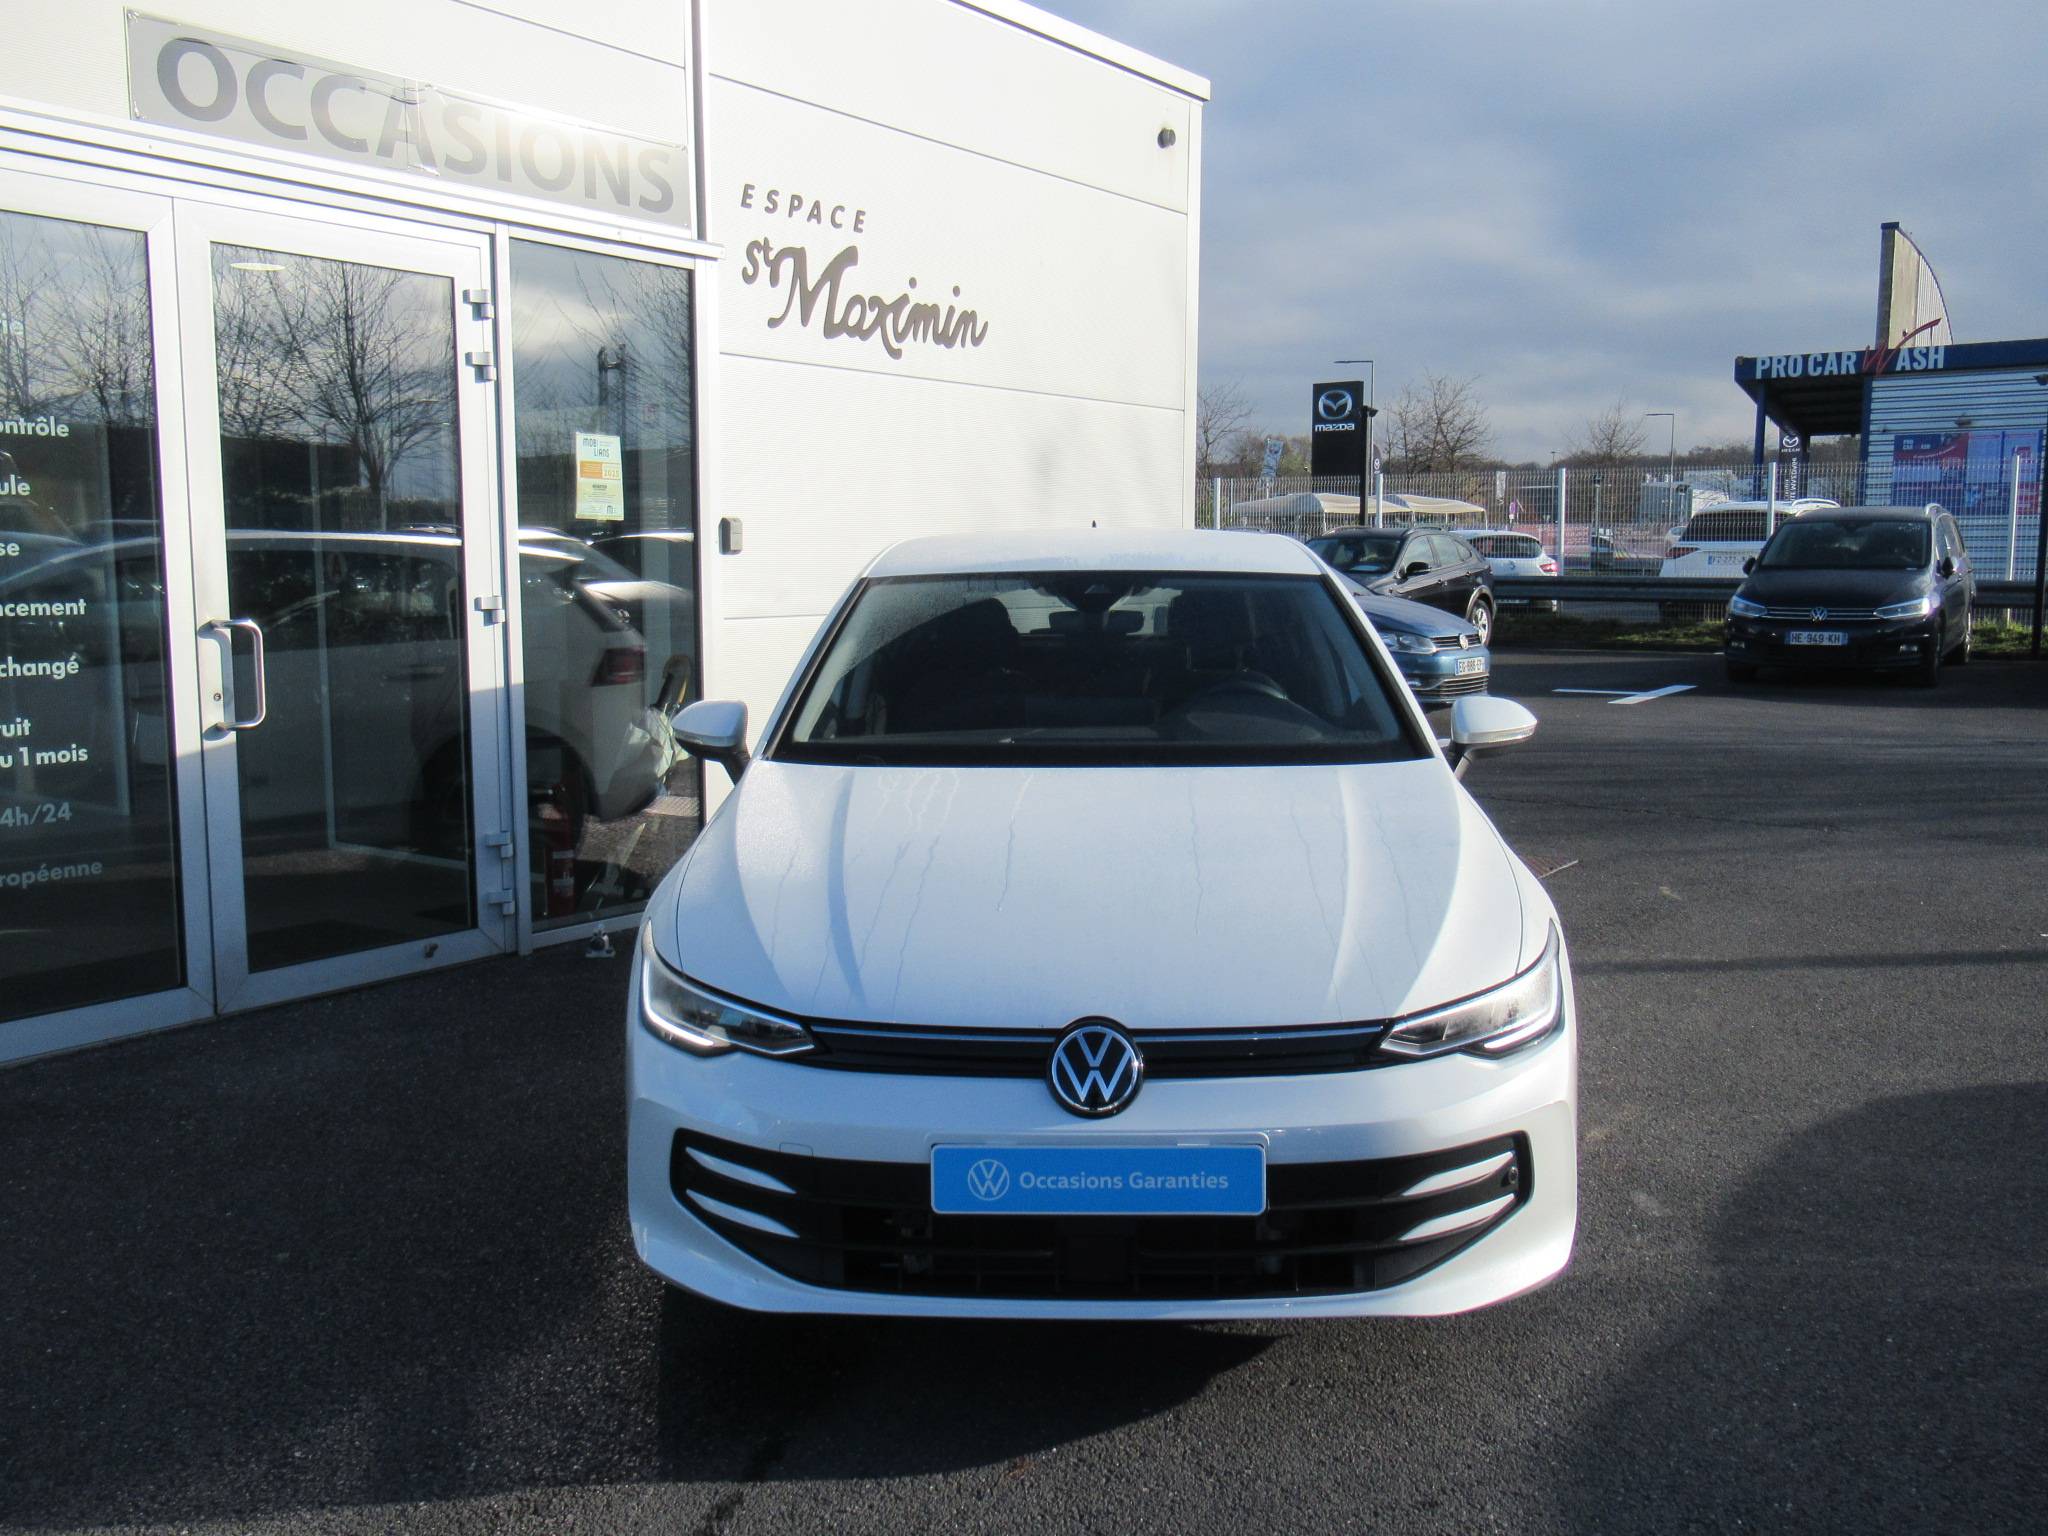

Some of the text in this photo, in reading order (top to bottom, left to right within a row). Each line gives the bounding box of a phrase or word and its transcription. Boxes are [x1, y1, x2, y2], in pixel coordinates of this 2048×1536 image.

[156, 36, 674, 213] OCCASIONS
[740, 183, 866, 233] ESPACE
[767, 246, 989, 360] Maximin
[1755, 355, 1802, 379] PRO
[1807, 351, 1856, 377] CAR
[19, 747, 30, 766] 1
[36, 743, 88, 765] mois
[1019, 1170, 1123, 1190] Occasions
[1128, 1170, 1229, 1190] Garanties
